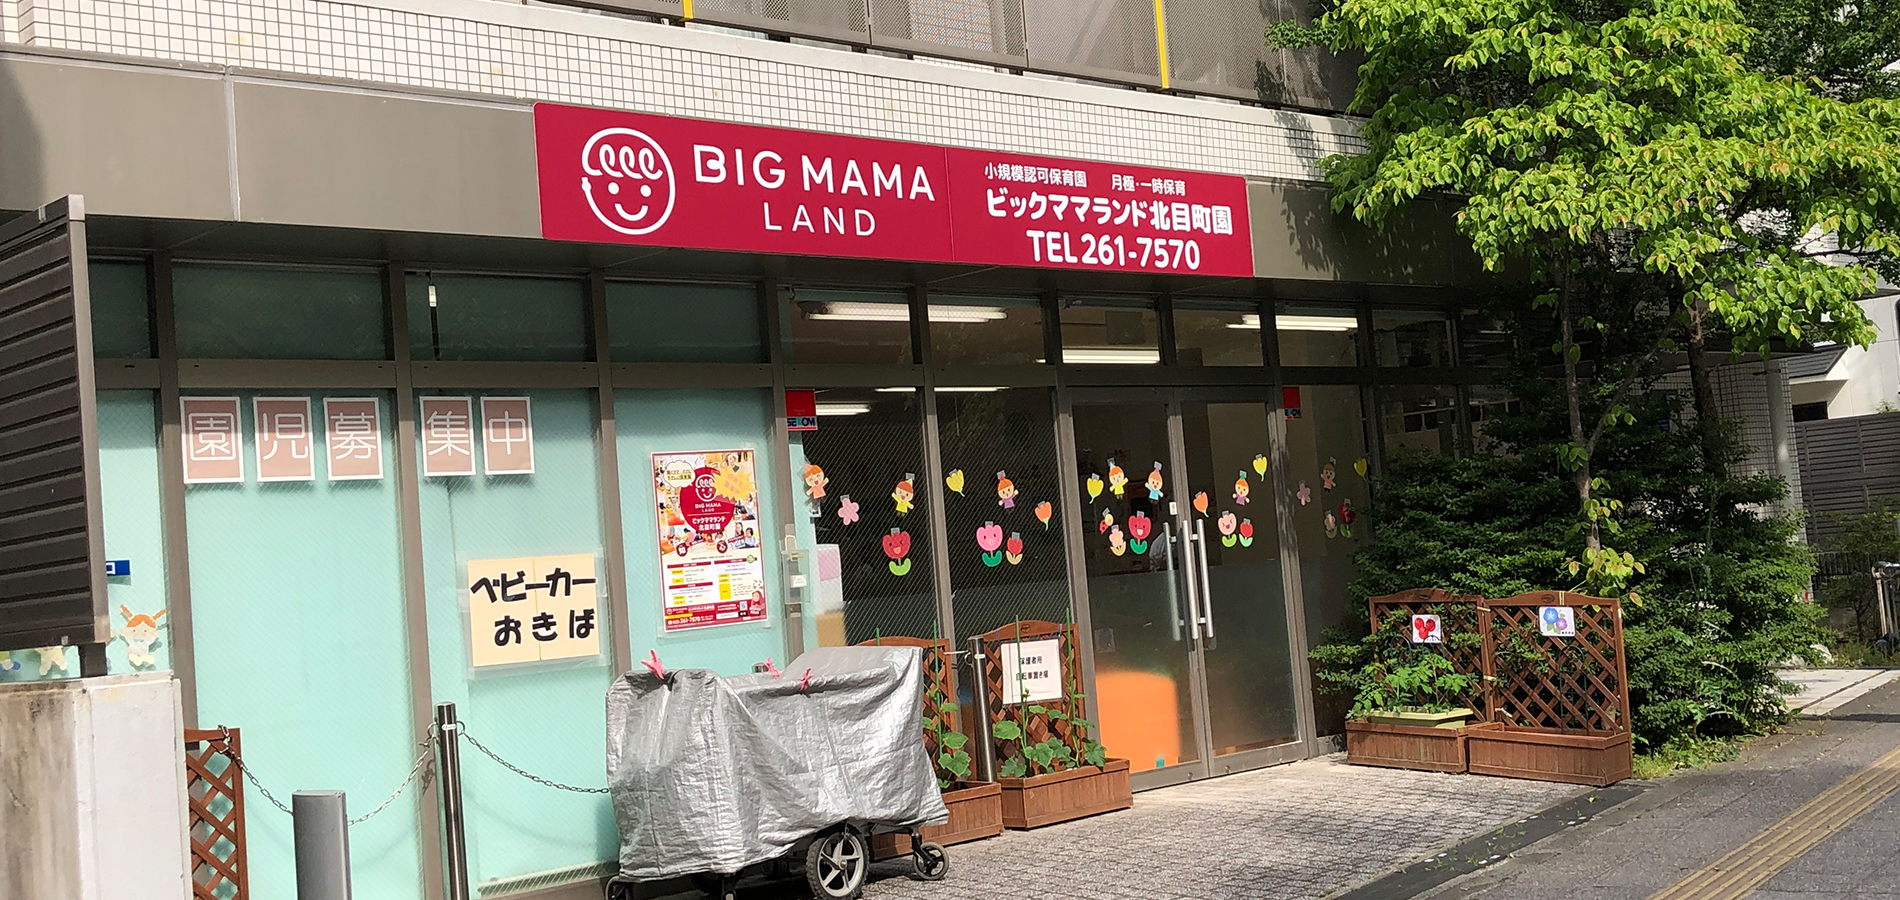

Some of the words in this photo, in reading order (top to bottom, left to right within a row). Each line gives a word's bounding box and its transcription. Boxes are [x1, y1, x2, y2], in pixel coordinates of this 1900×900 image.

[693, 144, 786, 189] BIG
[801, 154, 936, 202] MAMA
[984, 162, 1087, 188] 小規模認可保育園
[763, 201, 876, 237] LAND
[986, 187, 1233, 236] ビックママランド北目町園
[188, 411, 527, 461] 園児募集中
[787, 417, 816, 426] SECOM
[470, 567, 597, 604] ベビーカー
[494, 608, 595, 647] おきば
